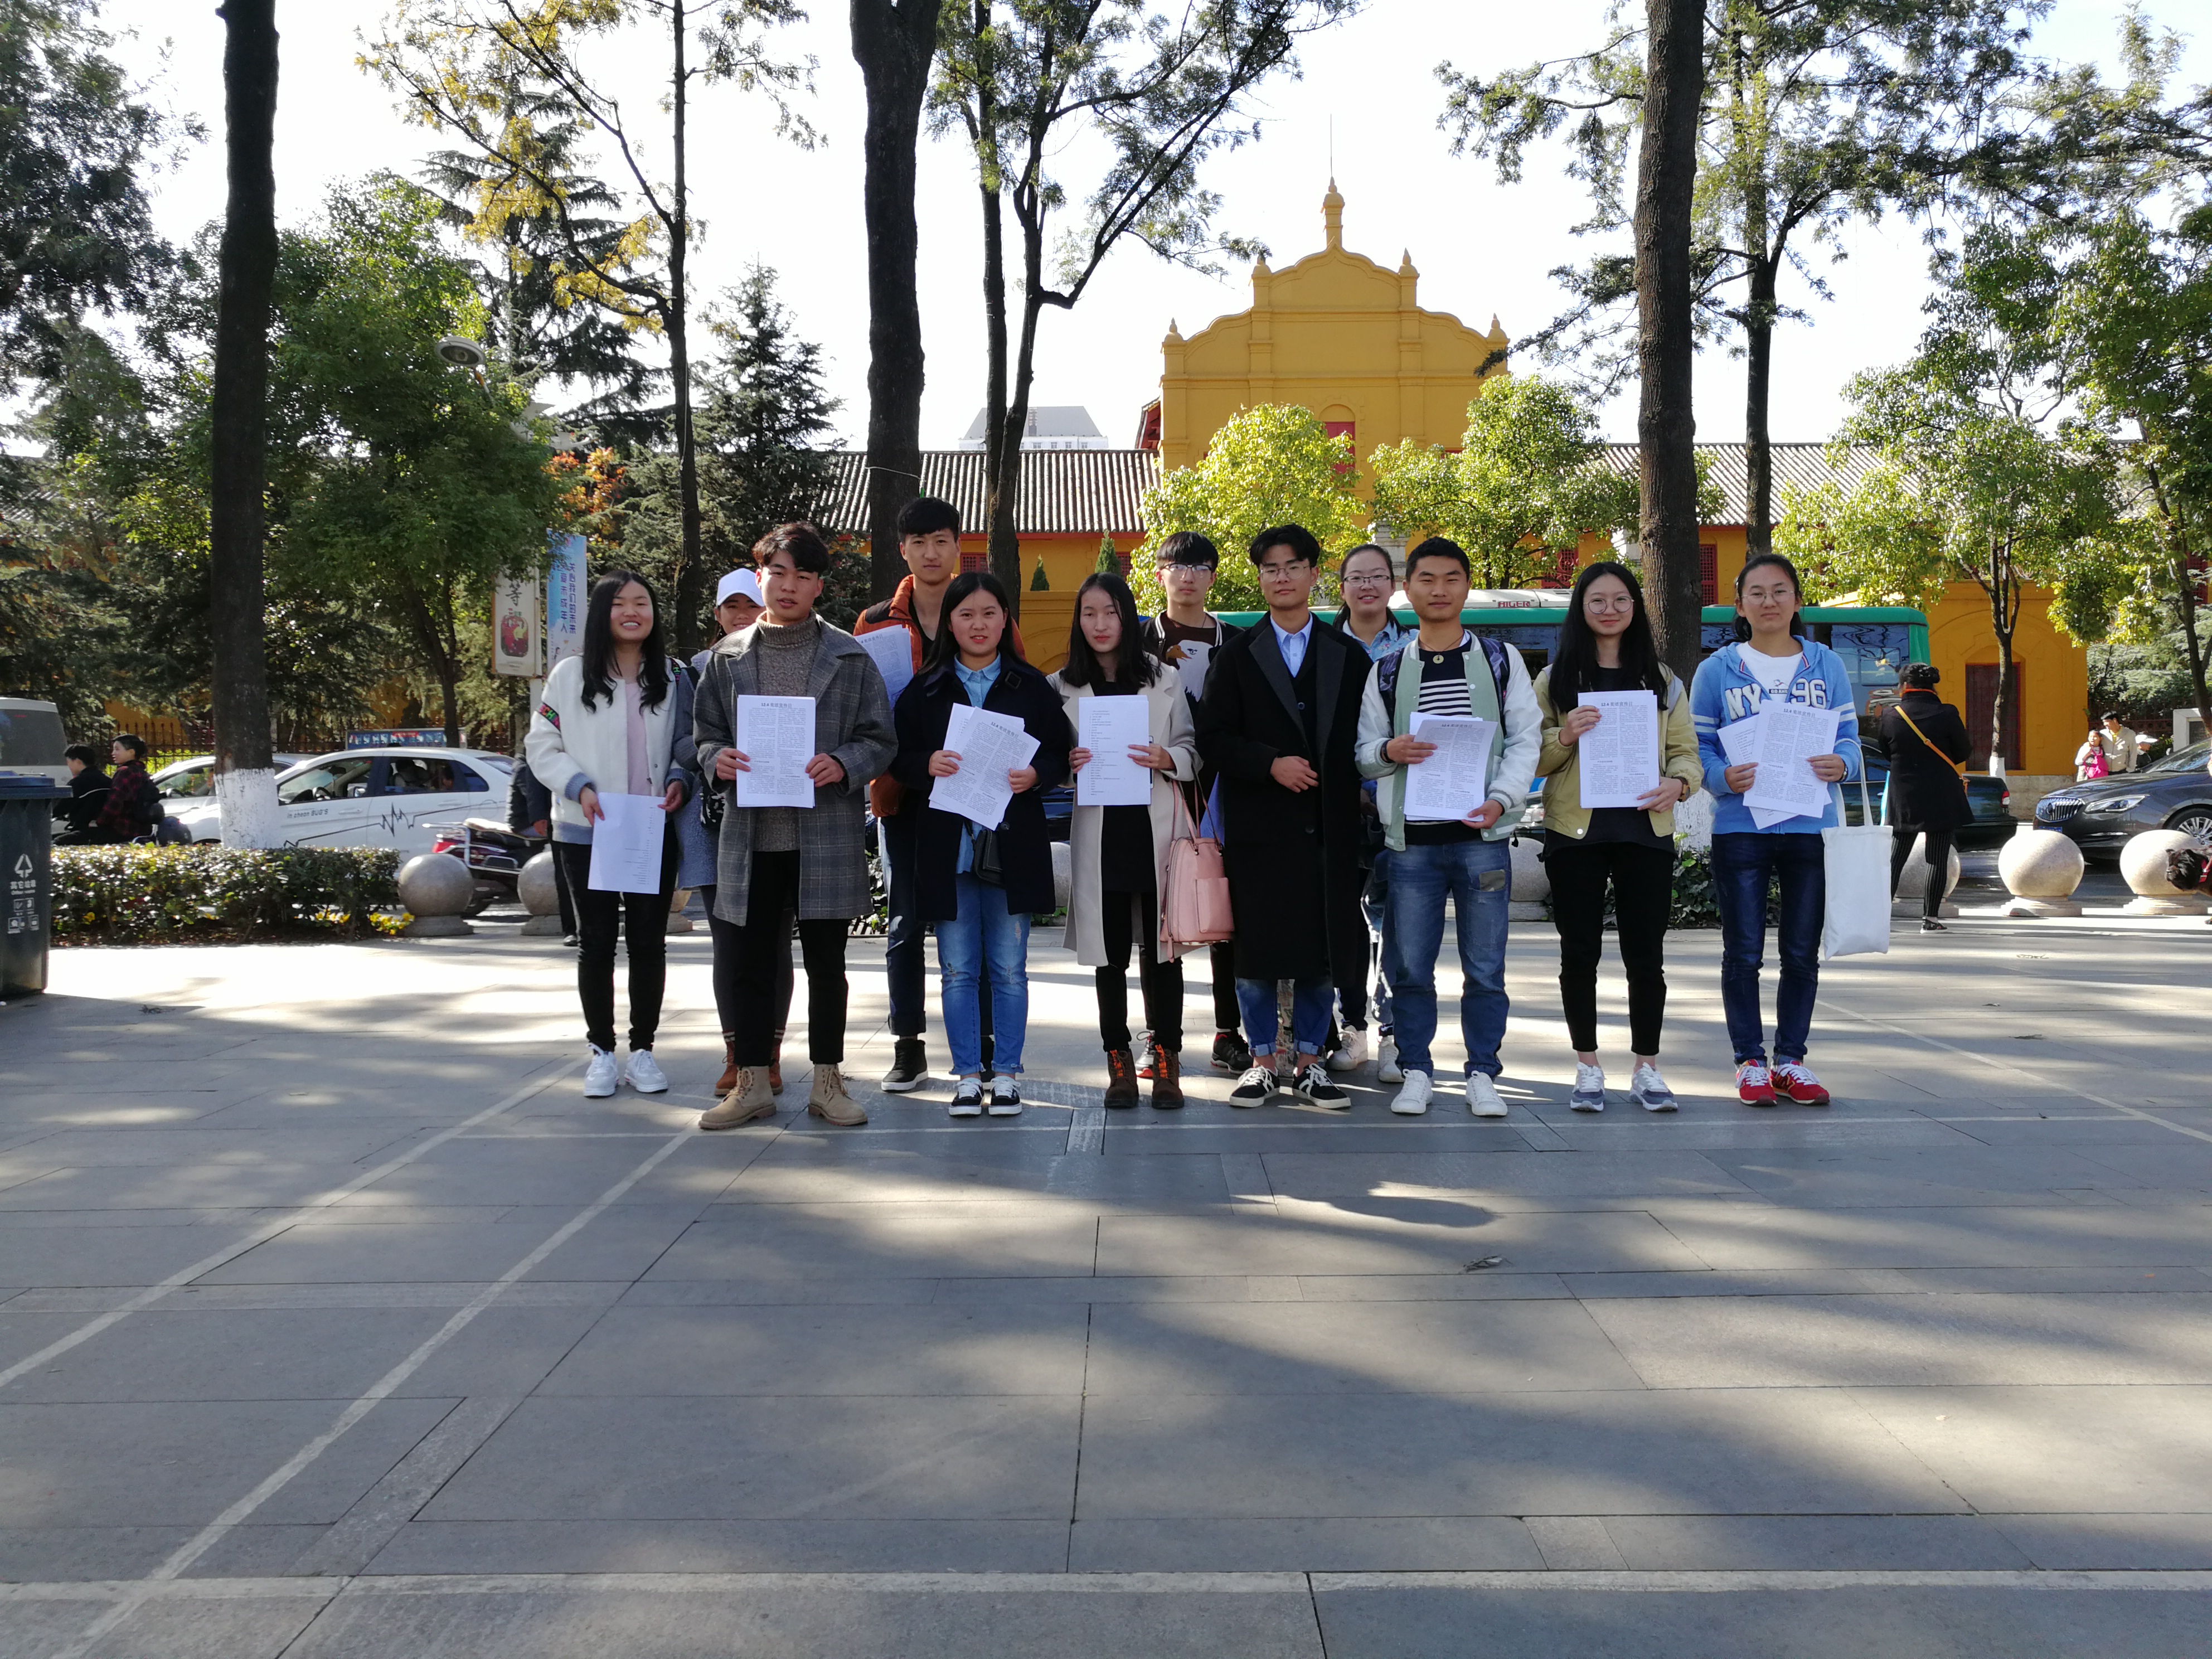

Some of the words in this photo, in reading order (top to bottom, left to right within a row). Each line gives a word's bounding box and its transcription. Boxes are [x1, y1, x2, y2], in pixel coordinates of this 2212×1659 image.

[505, 582, 522, 607] 等
[1725, 683, 1762, 721] NY
[1791, 677, 1827, 710] 96
